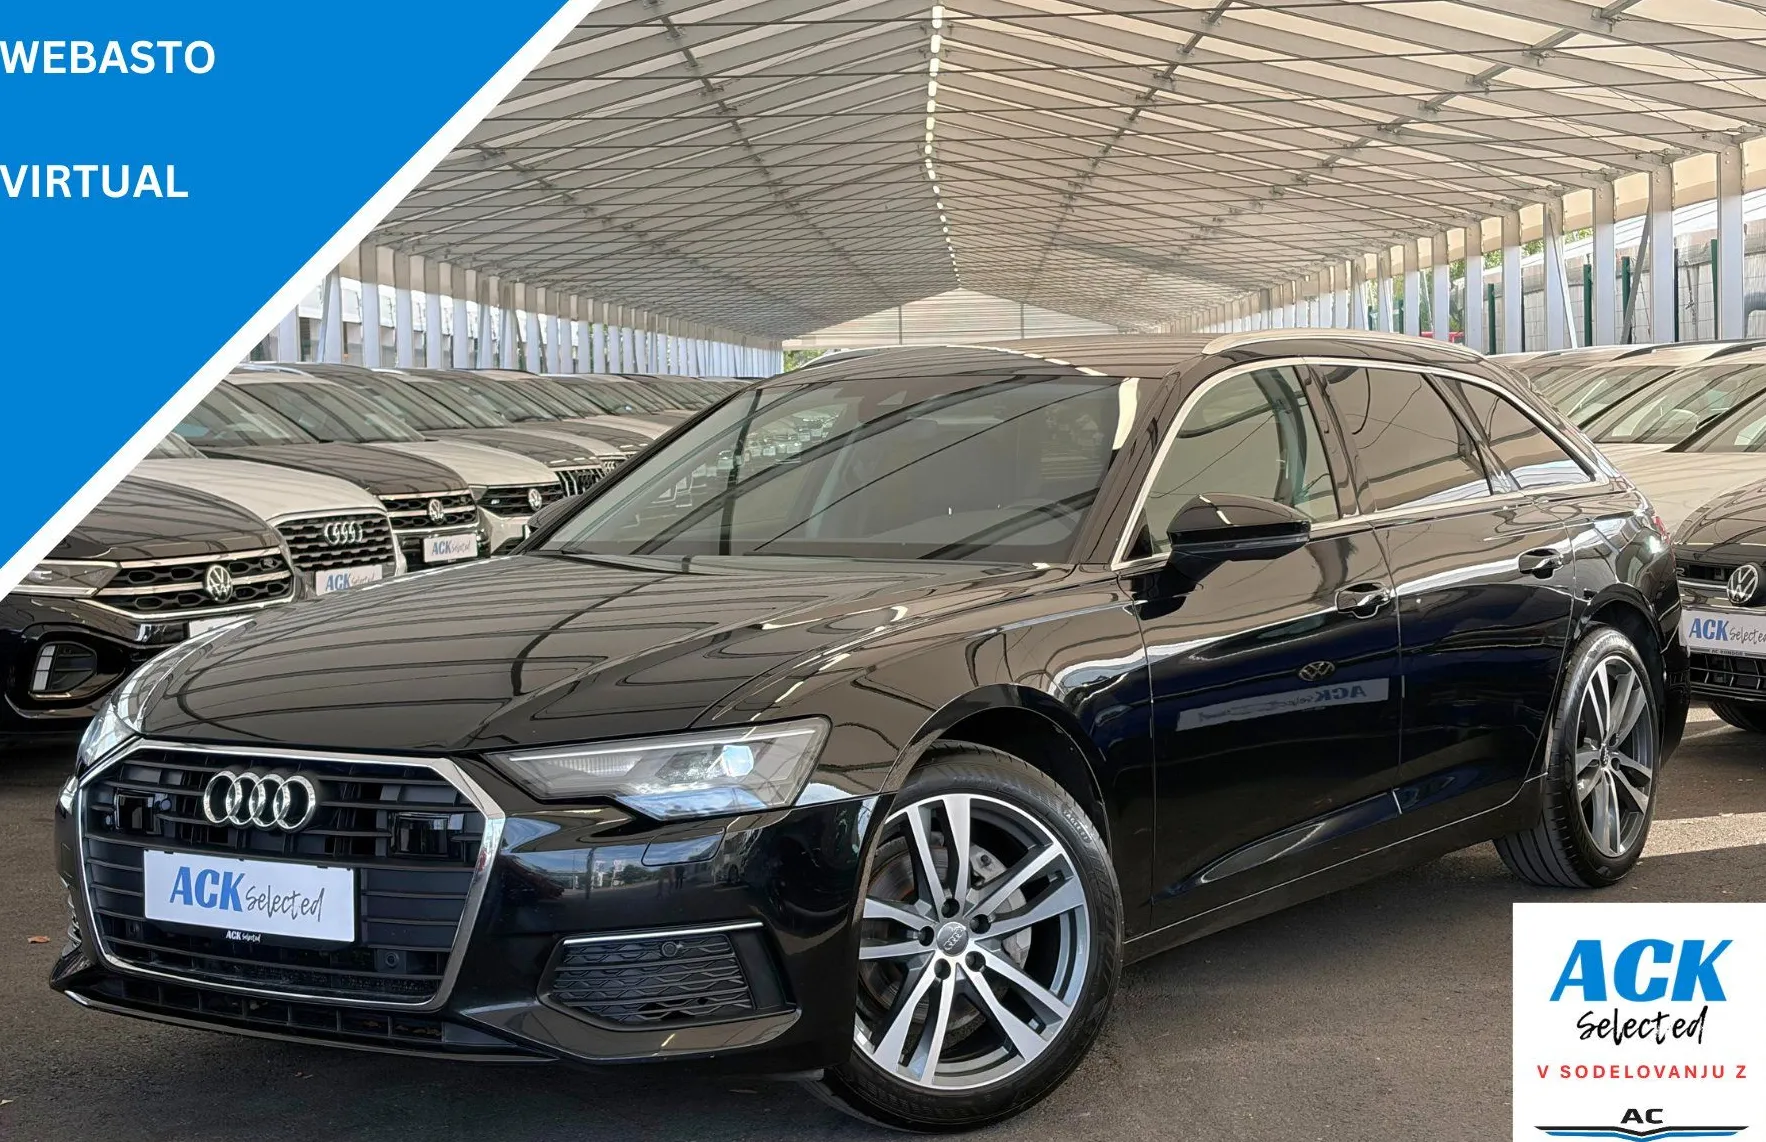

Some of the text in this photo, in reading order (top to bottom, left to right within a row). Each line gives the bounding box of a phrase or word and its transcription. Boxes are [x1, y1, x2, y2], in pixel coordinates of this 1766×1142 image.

[326, 573, 351, 590] ACK
[1689, 617, 1729, 641] ACK
[169, 866, 325, 922] ACK Selected
[226, 930, 242, 940] ACK
